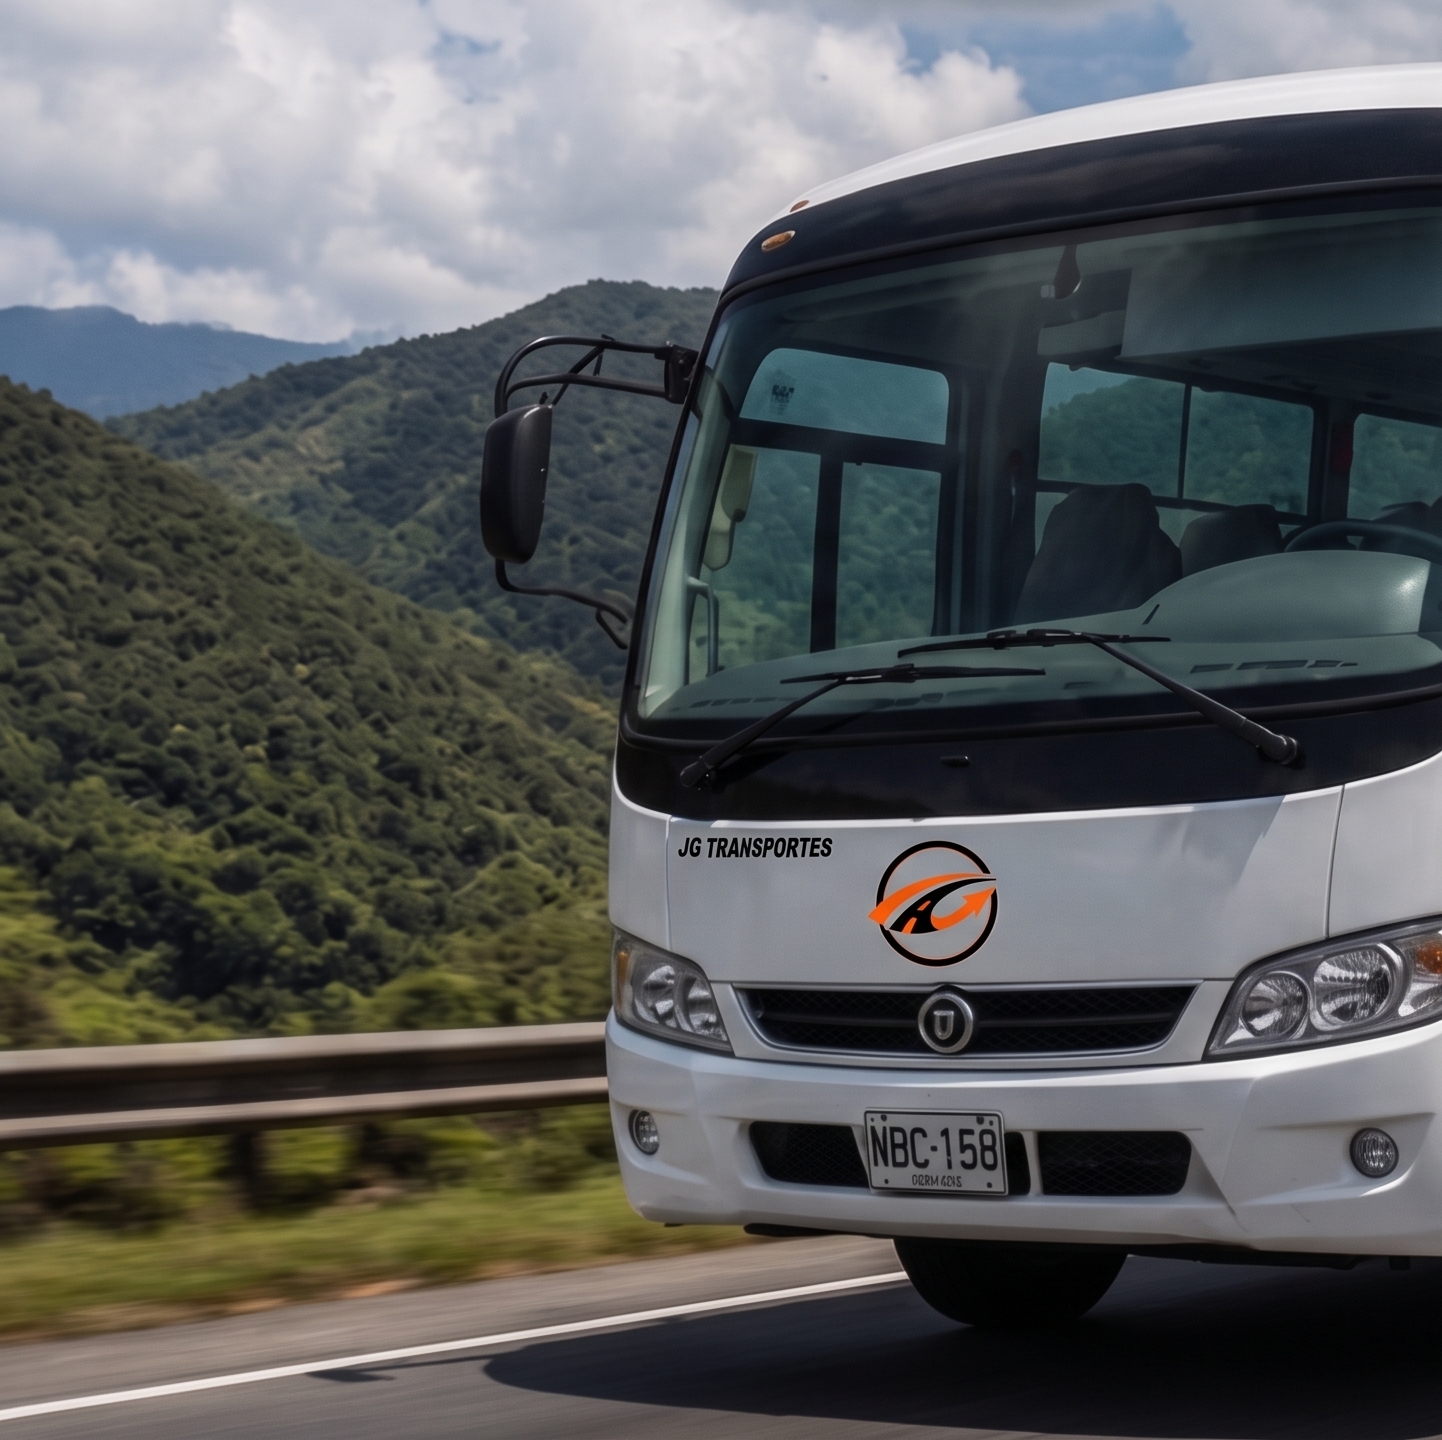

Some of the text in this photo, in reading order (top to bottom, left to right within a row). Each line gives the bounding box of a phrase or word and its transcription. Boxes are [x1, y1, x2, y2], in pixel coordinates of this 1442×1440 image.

[677, 836, 833, 859] JG TRANSPORTES
[869, 1125, 999, 1172] NBC-158
